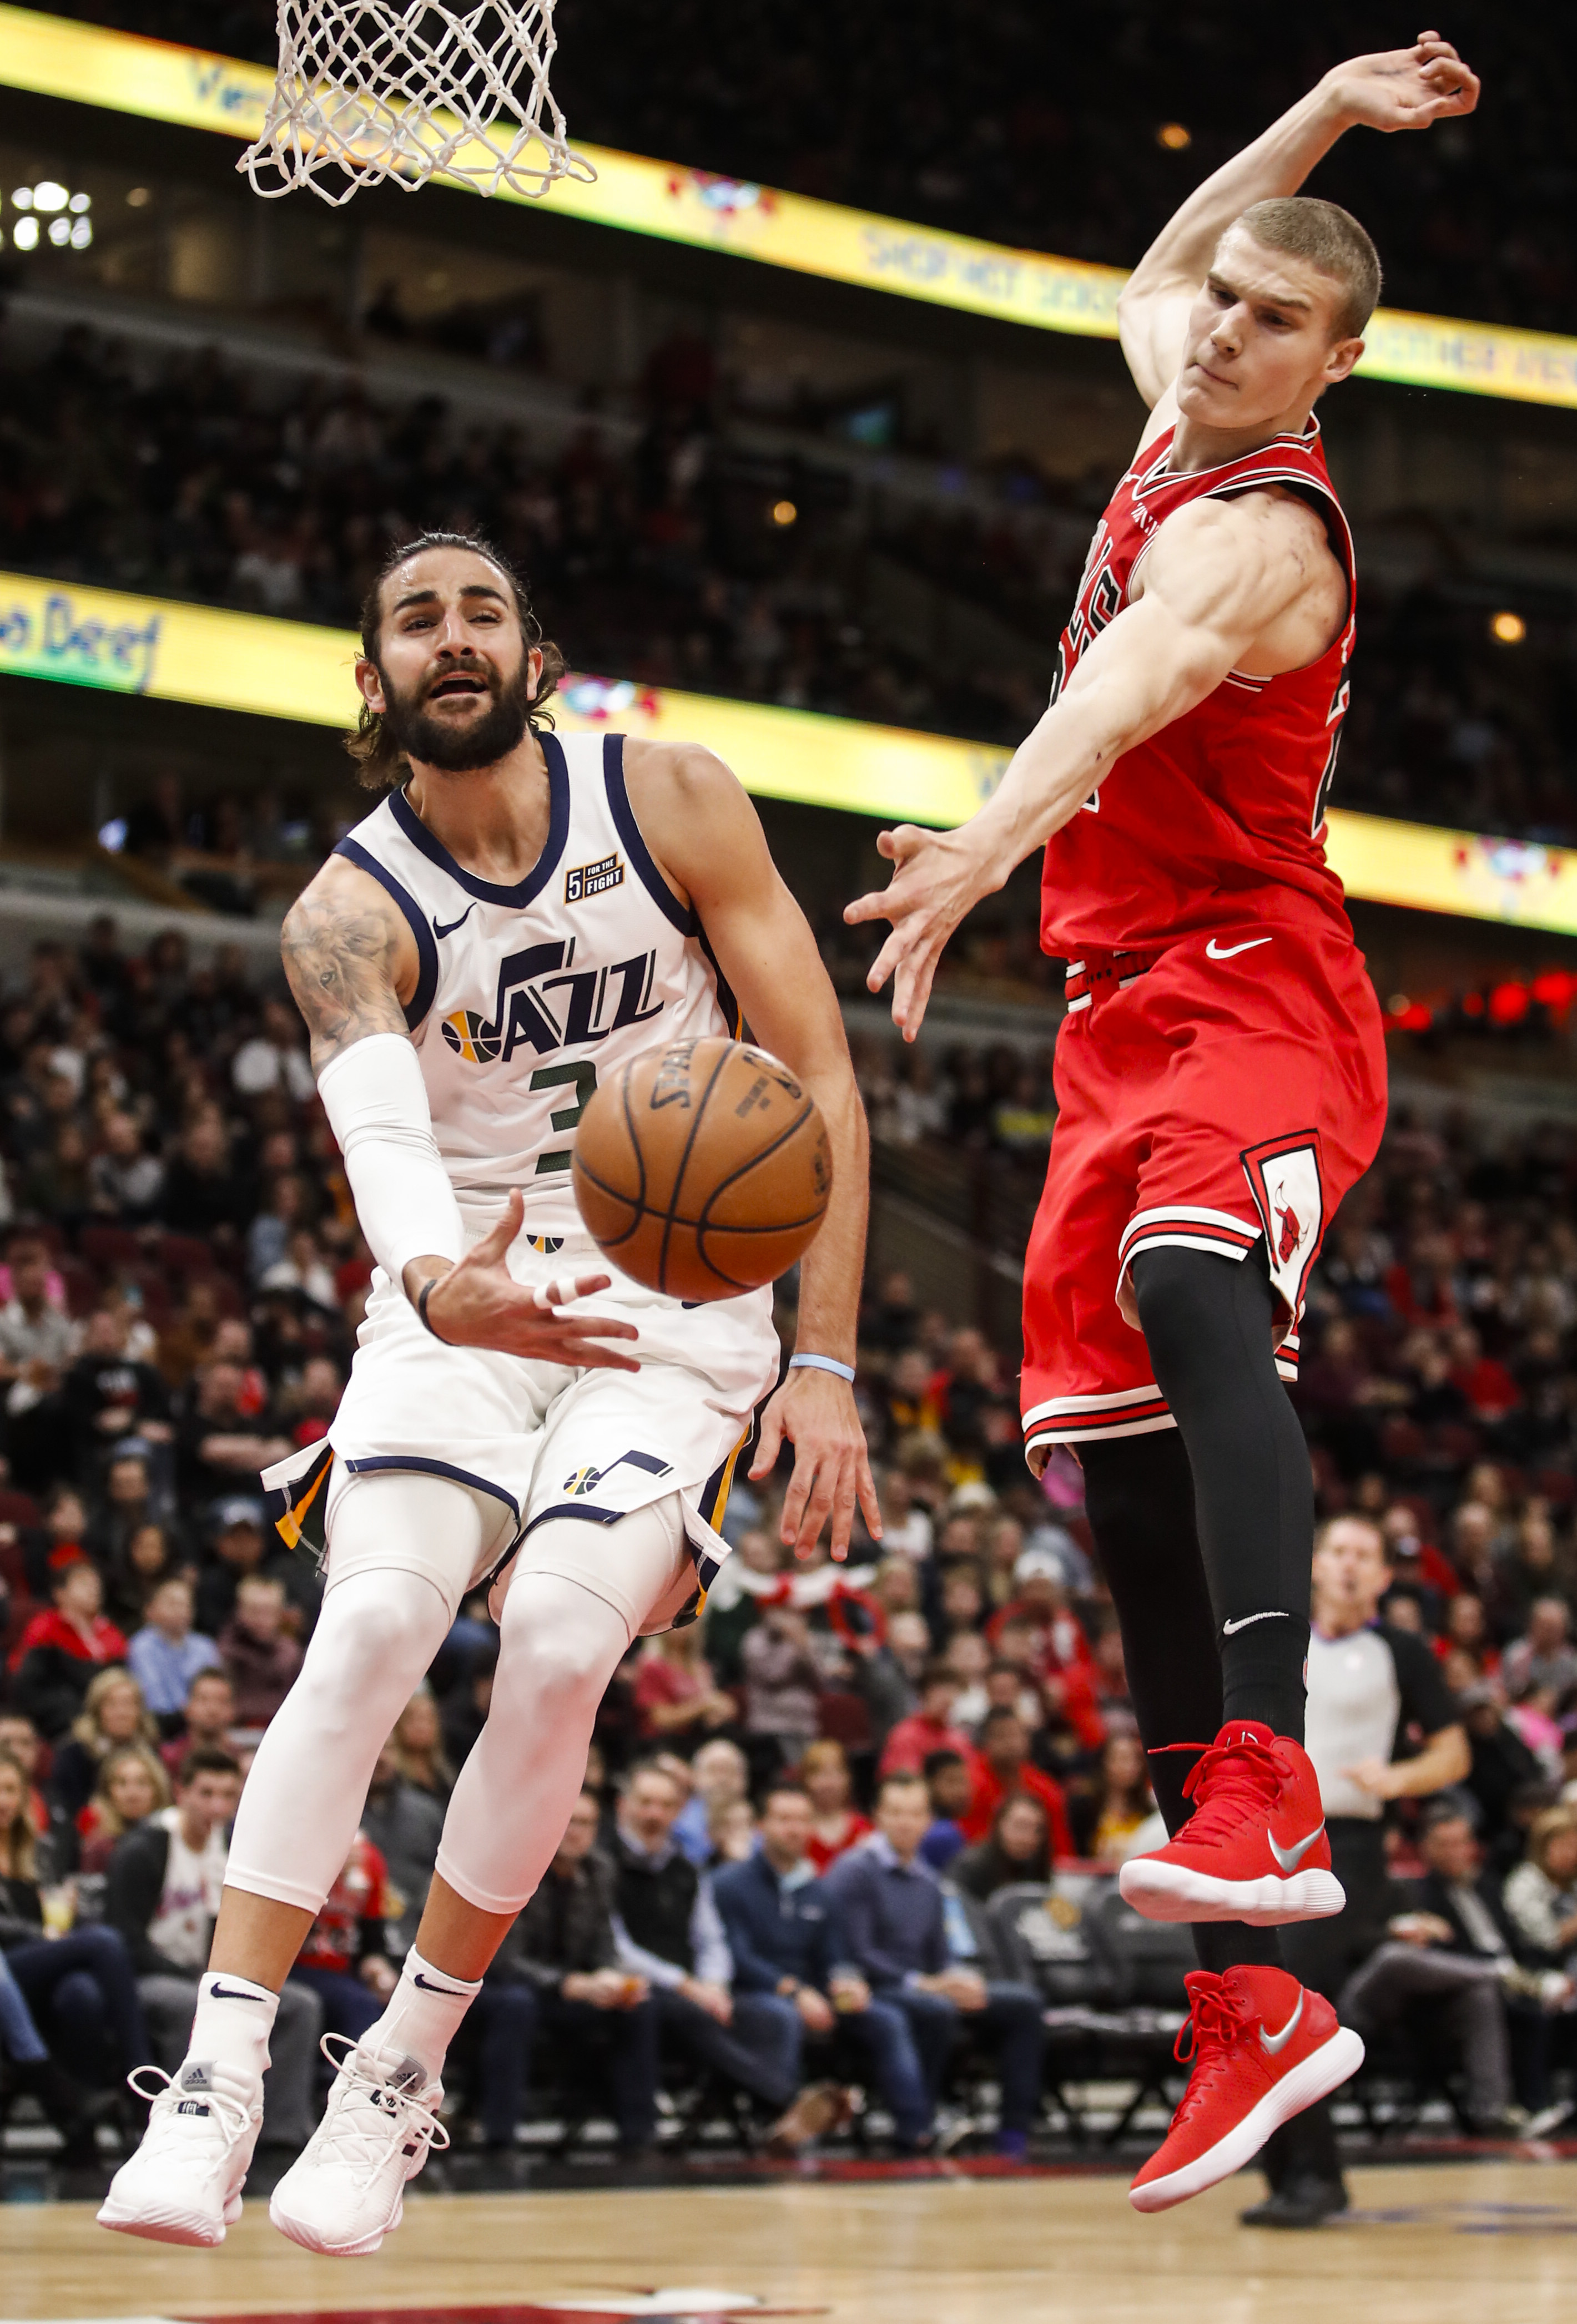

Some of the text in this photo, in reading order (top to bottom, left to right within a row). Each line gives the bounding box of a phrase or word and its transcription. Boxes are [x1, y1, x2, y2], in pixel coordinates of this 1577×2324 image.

[587, 858, 614, 876] FOR THE
[568, 871, 581, 900] 5
[587, 869, 621, 895] FIGHT
[441, 936, 665, 1063] JAZZ
[529, 1060, 598, 1175] 3
